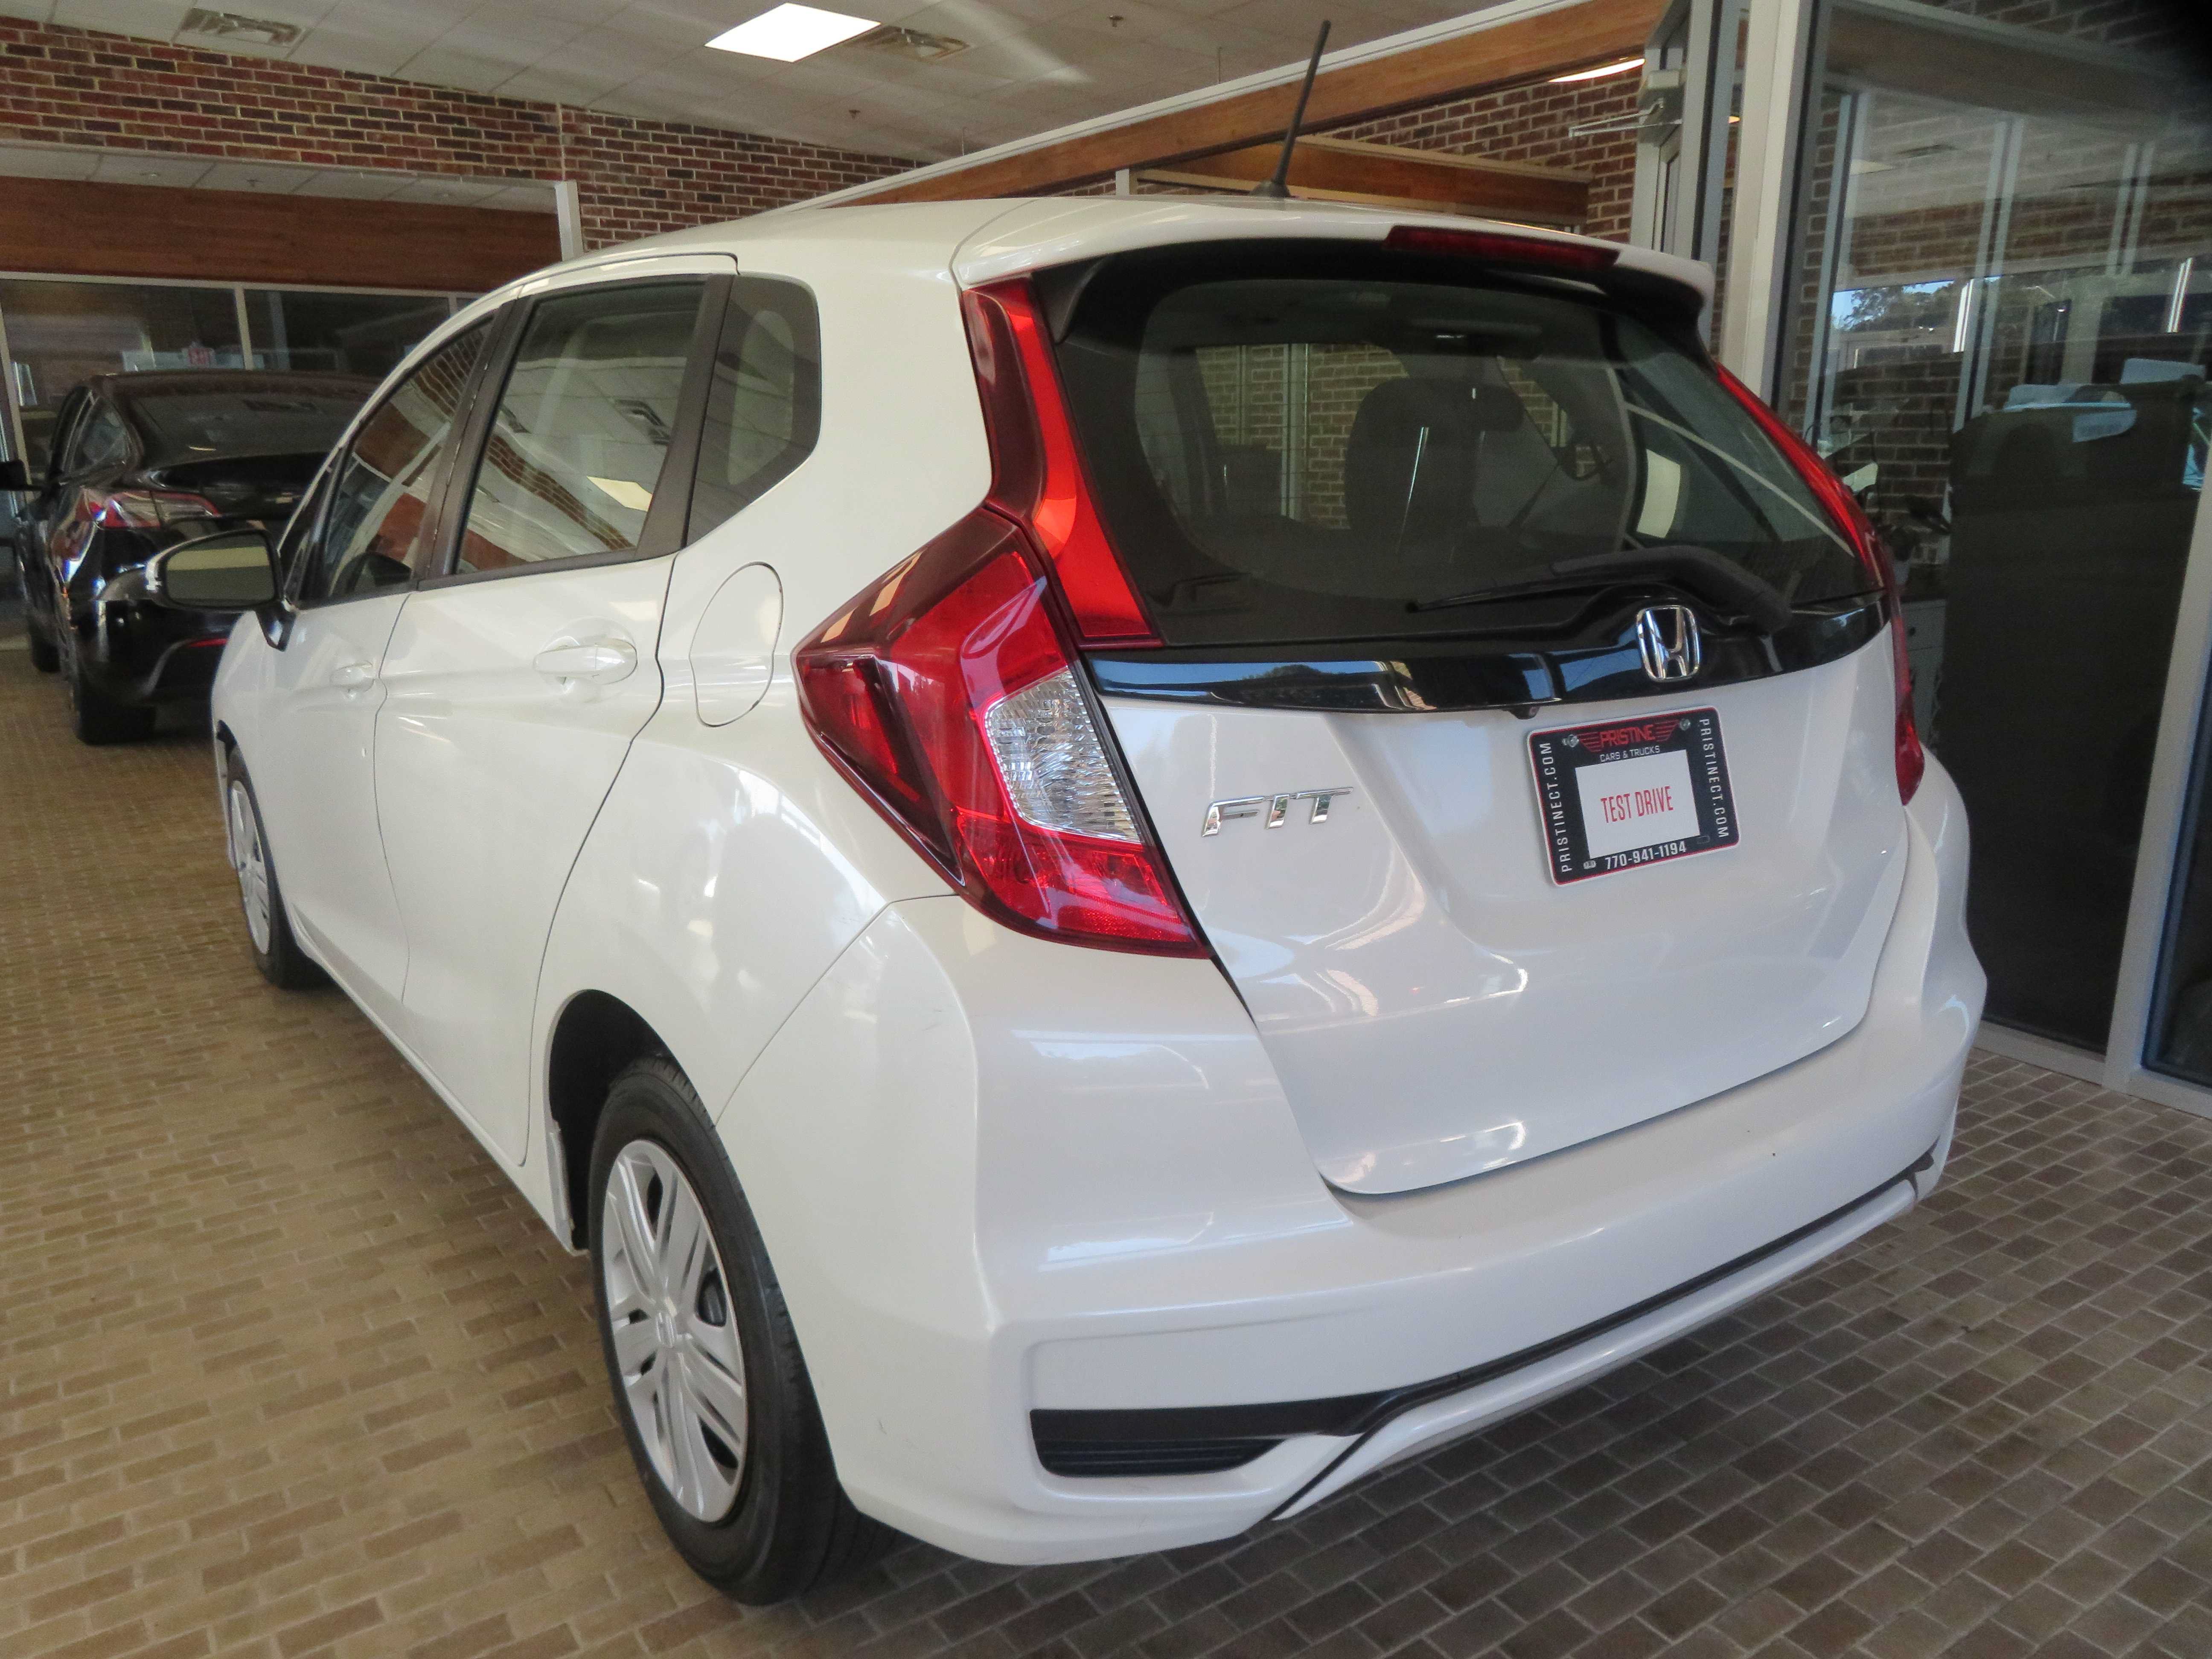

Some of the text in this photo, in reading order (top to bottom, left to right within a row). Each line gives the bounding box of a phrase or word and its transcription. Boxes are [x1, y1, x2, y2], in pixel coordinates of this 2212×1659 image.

[1599, 724, 1655, 747] PRISTINE
[1599, 745, 1660, 763] CARS & TRUCKS
[1698, 719, 1729, 838] PRISTINECT.COM
[1201, 786, 1354, 838] FIT
[1539, 742, 1573, 873] PRISTINECT.COM
[1600, 785, 1674, 824] TEST DRIVE
[1604, 841, 1687, 870] 770-941-1194
